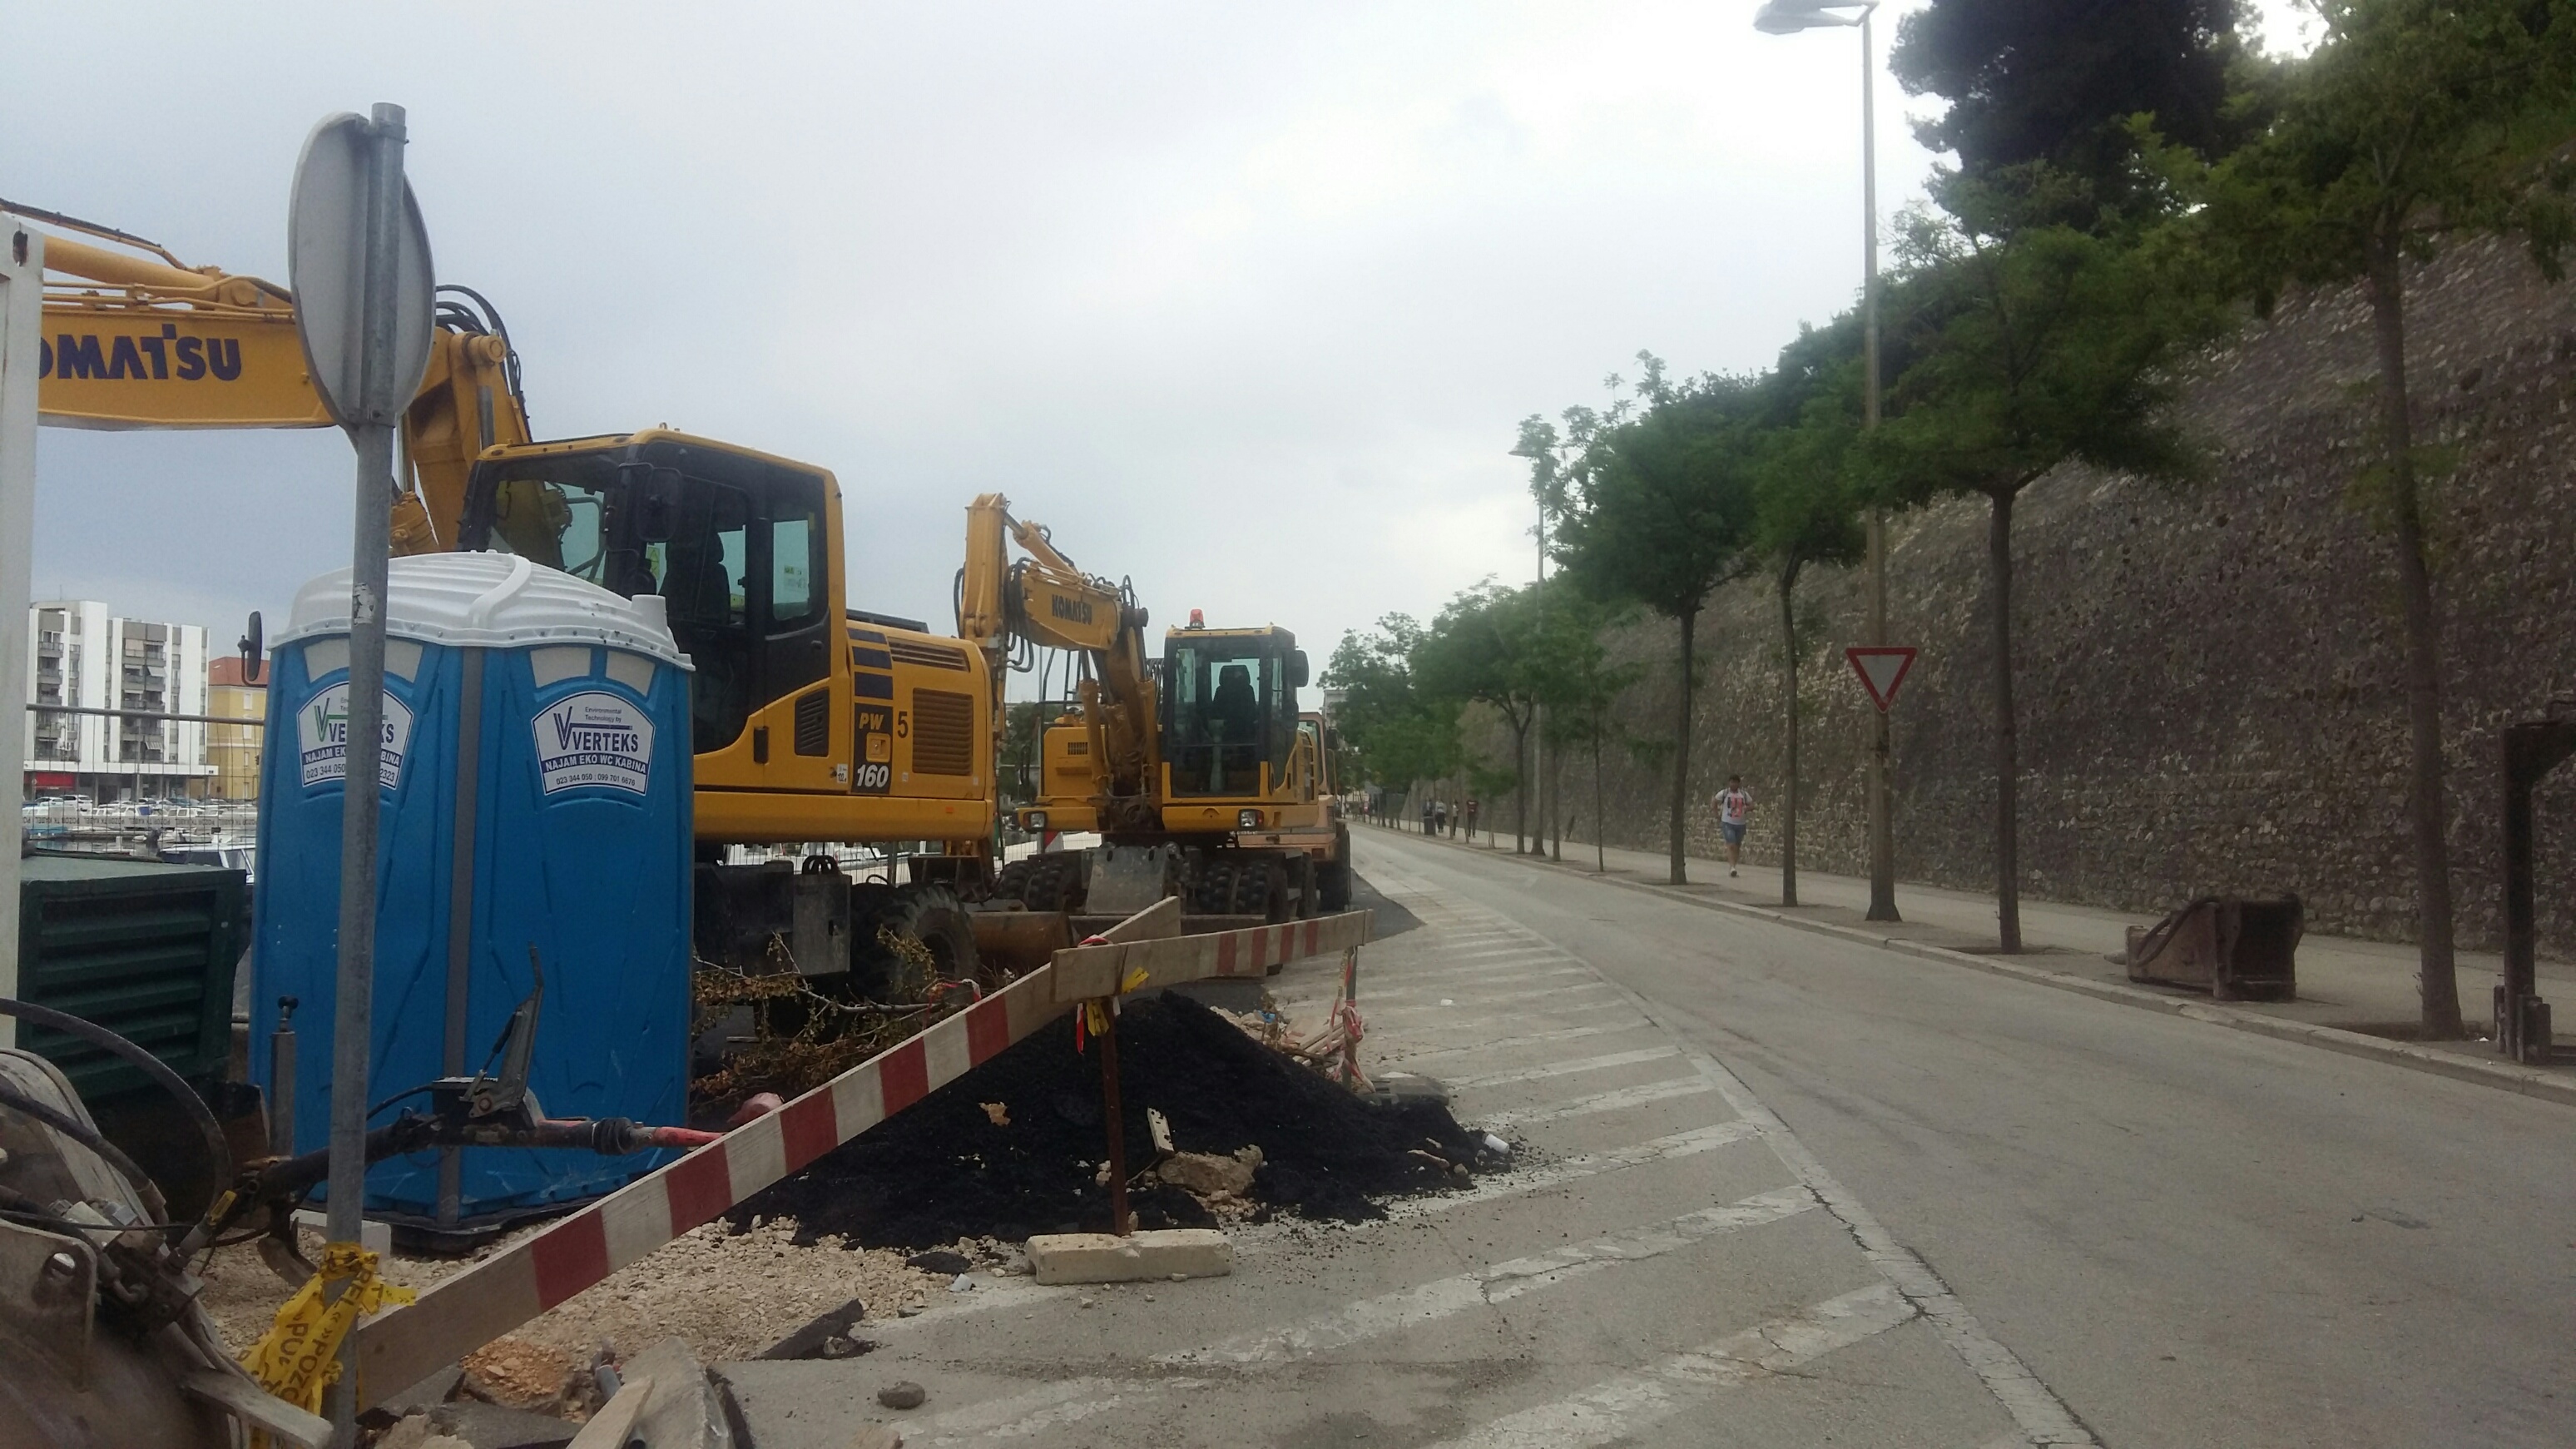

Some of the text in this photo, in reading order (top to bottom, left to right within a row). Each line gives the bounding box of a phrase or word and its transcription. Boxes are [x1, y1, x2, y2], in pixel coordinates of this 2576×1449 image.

[39, 324, 241, 380] MATSU
[1052, 593, 1092, 626] KOMATSU
[585, 714, 614, 722] Technology
[859, 712, 884, 730] PW
[897, 711, 909, 738] 5
[305, 746, 399, 767] NAJAM EK BINA
[545, 754, 646, 774] NAJAM EKO WC KABINA
[305, 767, 318, 779] 023
[556, 777, 567, 785] 023
[569, 774, 580, 782] 344
[597, 773, 608, 782] 099
[857, 764, 889, 788] 160
[280, 1337, 329, 1404] POZO
